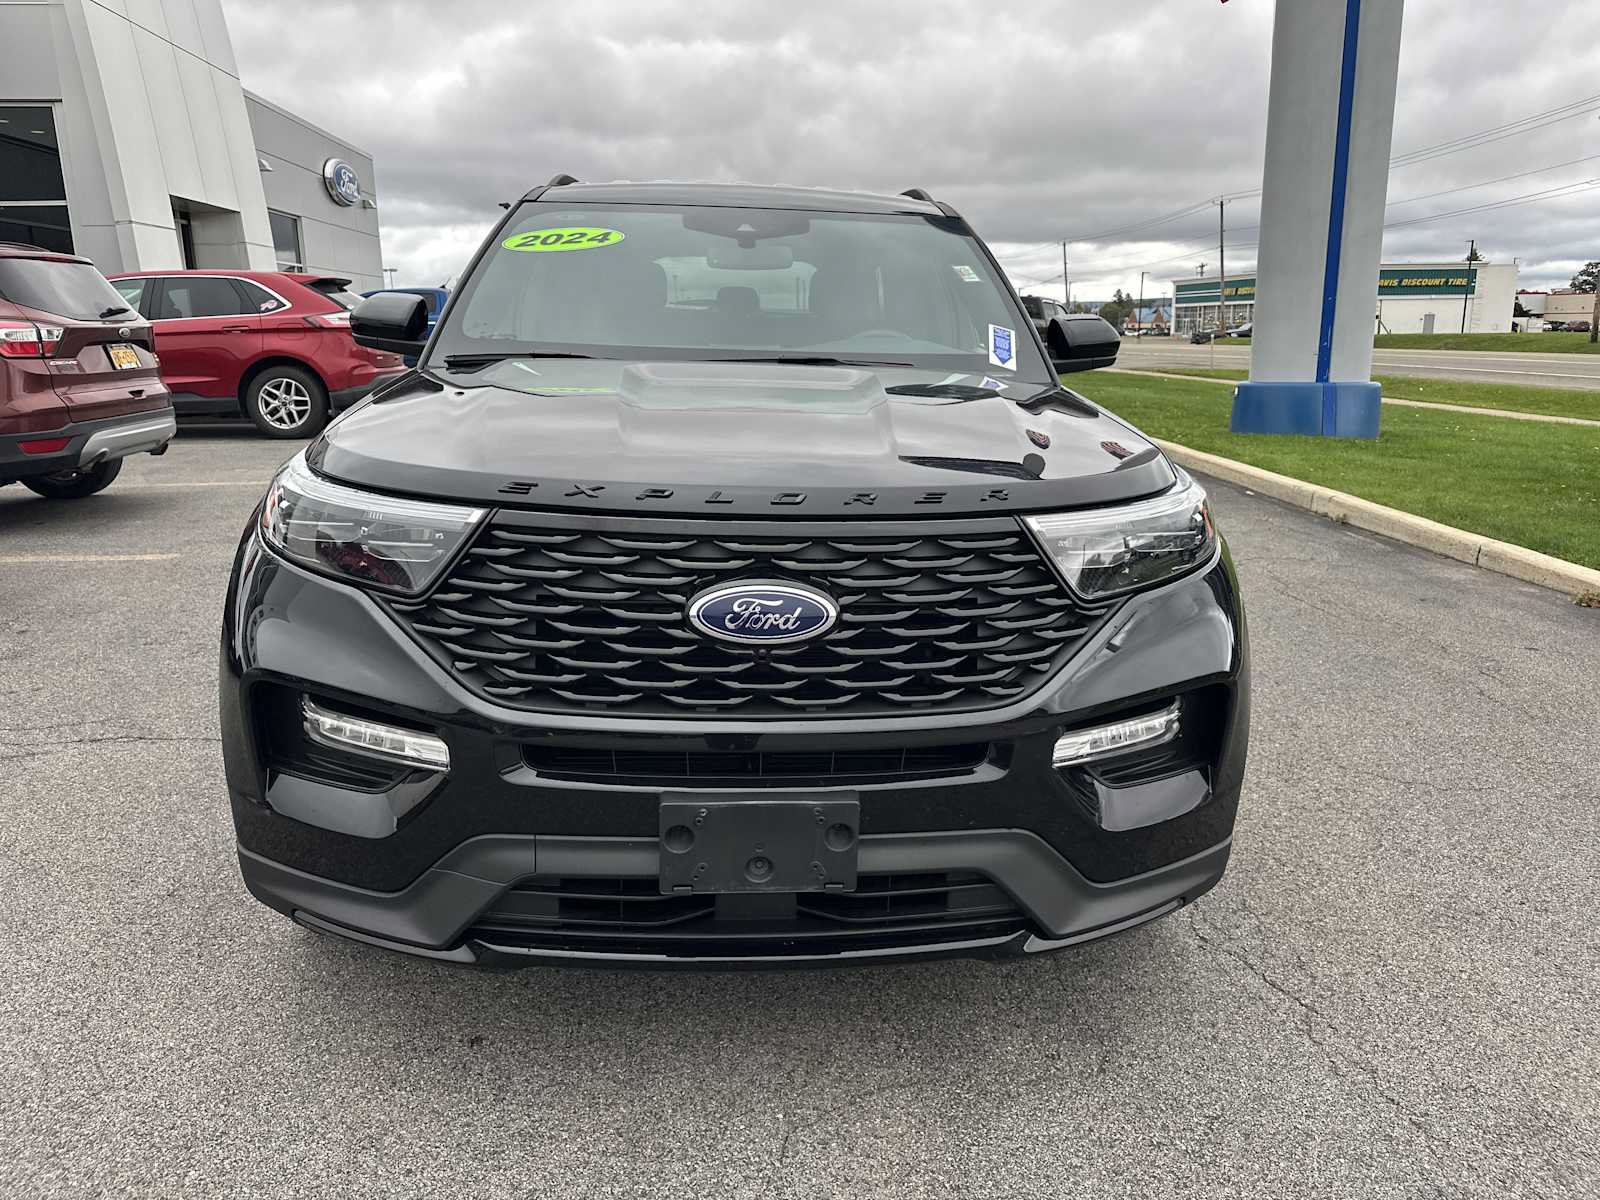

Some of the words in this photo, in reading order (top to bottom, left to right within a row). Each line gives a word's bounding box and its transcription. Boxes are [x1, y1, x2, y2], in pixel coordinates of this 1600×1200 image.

[514, 232, 612, 247] 2024
[1401, 278, 1446, 286] DISCOUNT
[1447, 278, 1468, 286] TIRE
[497, 481, 1009, 506] EXPLORER
[724, 598, 802, 631] Ford
